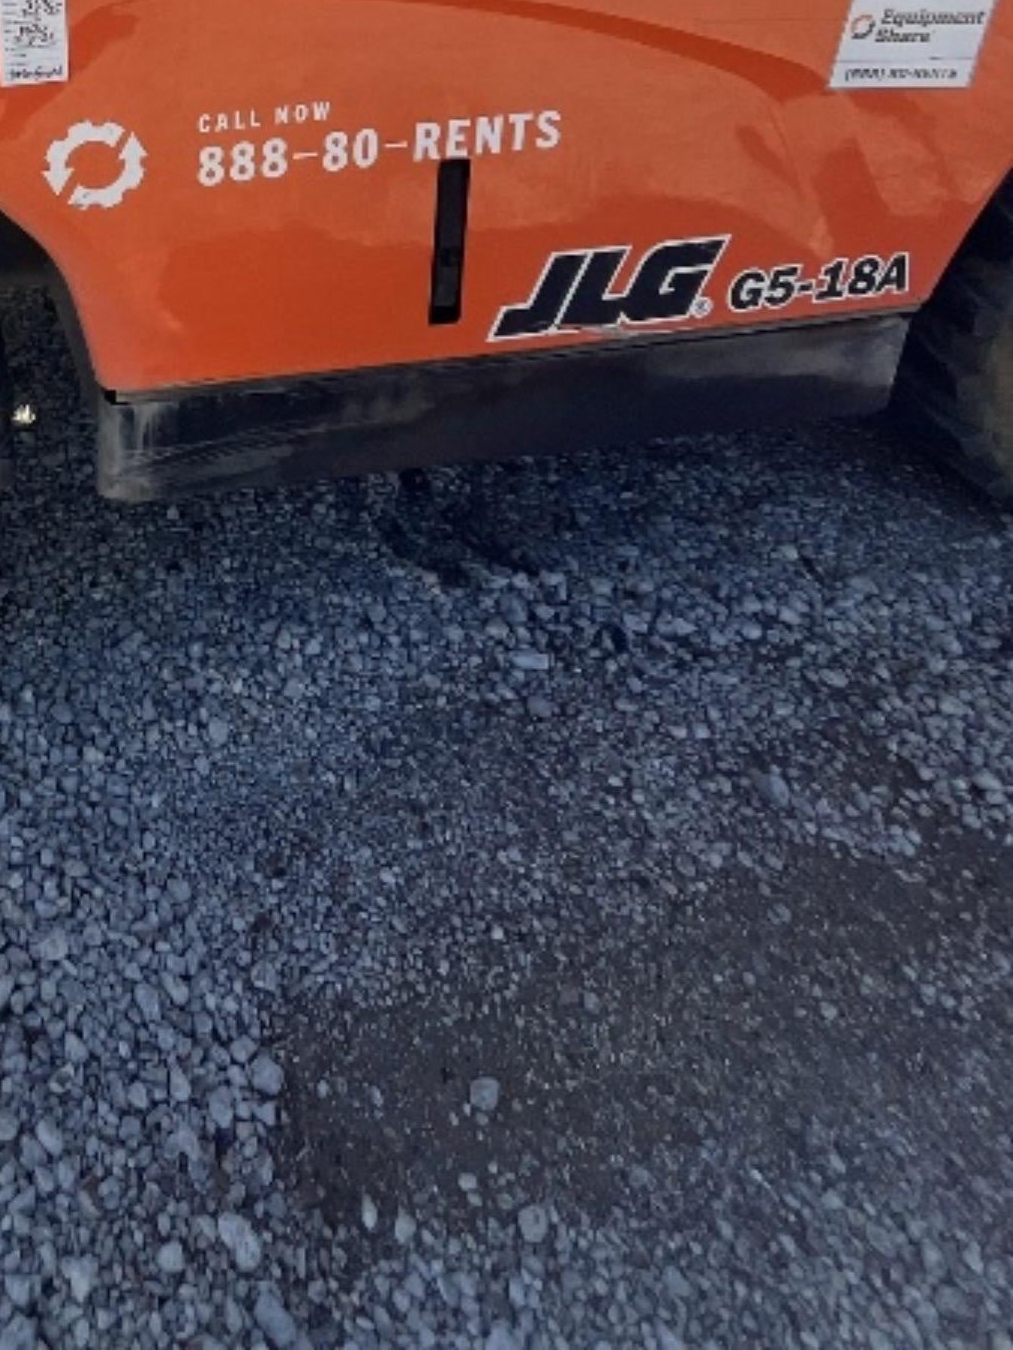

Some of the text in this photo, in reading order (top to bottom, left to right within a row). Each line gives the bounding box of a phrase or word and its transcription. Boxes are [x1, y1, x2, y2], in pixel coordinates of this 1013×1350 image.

[881, 8, 985, 26] Equipment
[875, 27, 931, 43] Share
[197, 101, 331, 133] CALL NOW
[197, 110, 561, 186] 888-80-RENTS
[487, 234, 909, 341] JLG G5-18A
